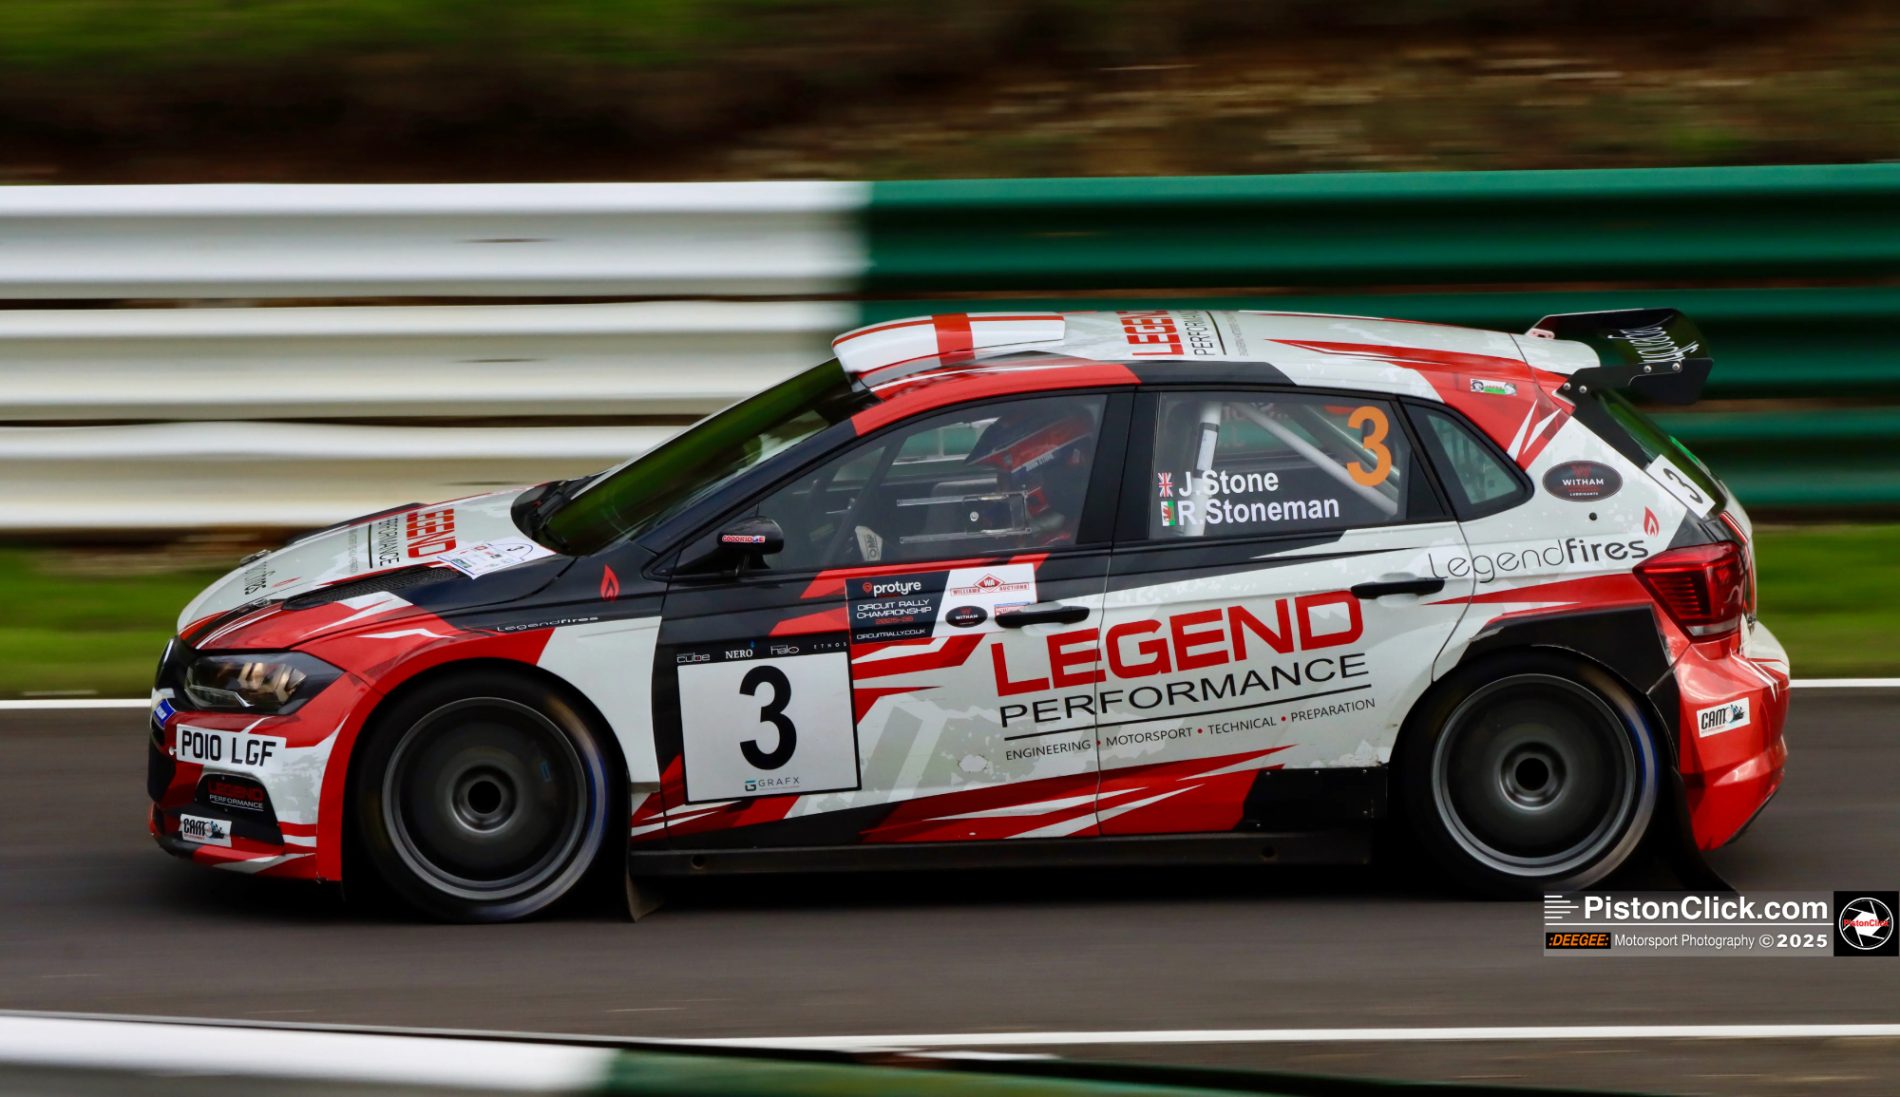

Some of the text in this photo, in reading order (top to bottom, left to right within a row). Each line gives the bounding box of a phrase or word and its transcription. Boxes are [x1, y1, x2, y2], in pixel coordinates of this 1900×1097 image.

[1116, 310, 1184, 356] LEGEN
[1346, 406, 1393, 487] 3
[1178, 470, 1280, 497] J.Stone
[1663, 468, 1703, 504] 3
[1178, 498, 1340, 526] R.Stoneman
[873, 581, 921, 597] protyre
[856, 606, 932, 619] CHAMPIONSHIP
[857, 599, 930, 611] CIRCUIT RALLY
[725, 649, 754, 659] NERO
[770, 645, 800, 655] halo
[991, 591, 1364, 697] LEGEND
[1000, 653, 1370, 728] PERFORMANCE
[739, 665, 797, 770] 3
[1005, 698, 1376, 761] ENGINEERING MOTORSPORT TECHNICAL PREPARATION
[1701, 708, 1726, 730] CAM
[231, 737, 277, 767] LGF
[758, 776, 800, 787] GRAFX
[209, 794, 264, 810] PERFORMANCE
